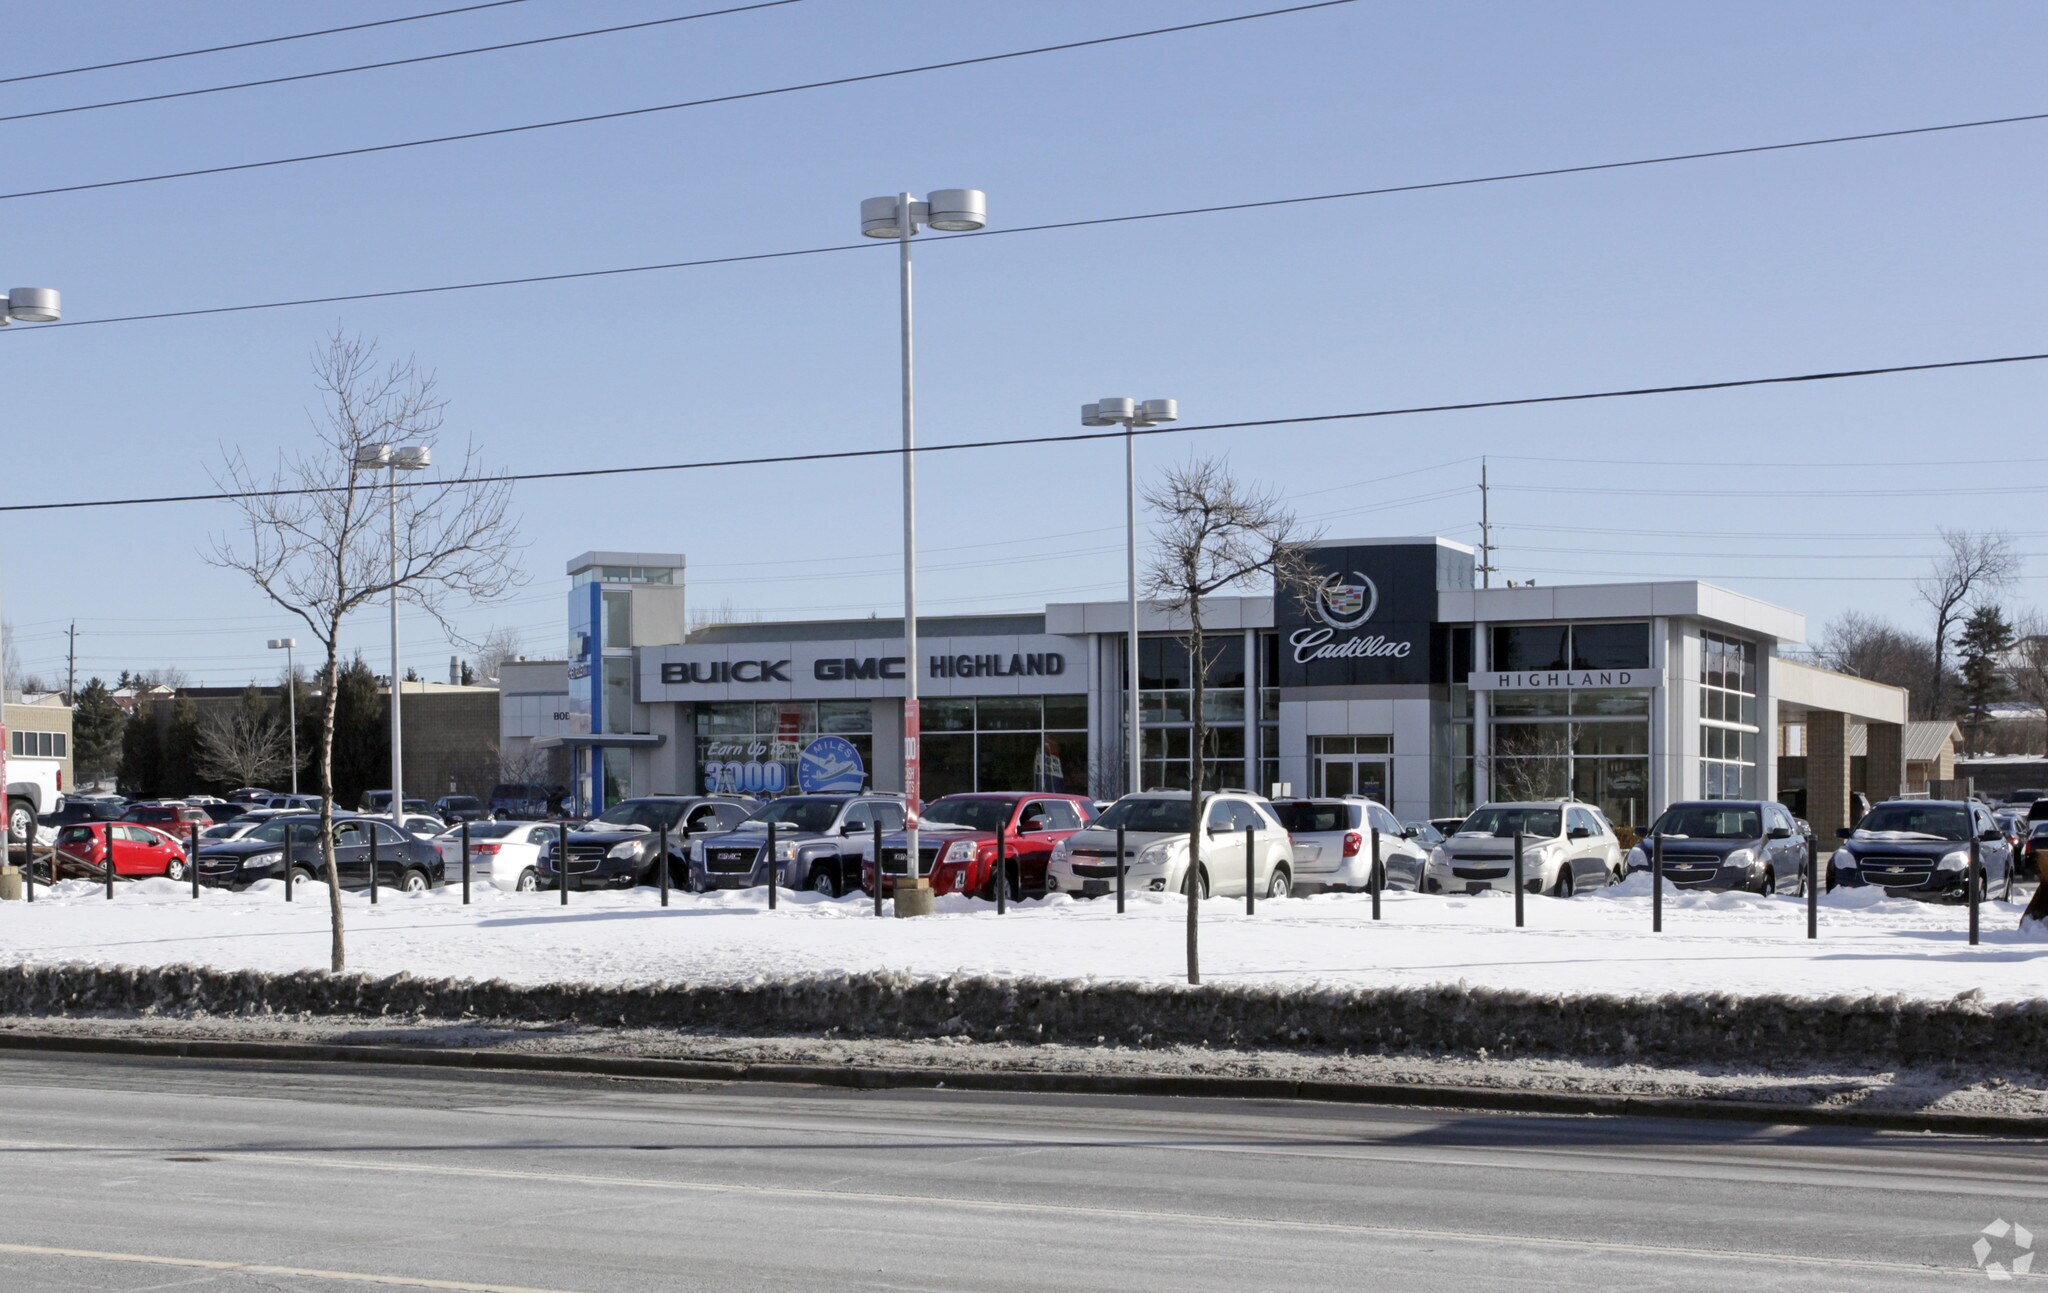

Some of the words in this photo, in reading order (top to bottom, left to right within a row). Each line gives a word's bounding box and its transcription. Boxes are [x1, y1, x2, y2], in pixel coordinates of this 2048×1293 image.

[1289, 628, 1411, 664] Cadillac
[661, 661, 790, 684] BUICK
[814, 657, 906, 681] GMC
[930, 653, 1065, 678] HIGHLAND
[1499, 672, 1632, 688] HIGHLAND
[707, 741, 744, 756] Earn
[747, 743, 767, 757] Up
[802, 762, 812, 788] AIR
[813, 740, 853, 758] MILES
[705, 761, 785, 793] 3000
[717, 852, 742, 860] GMC
